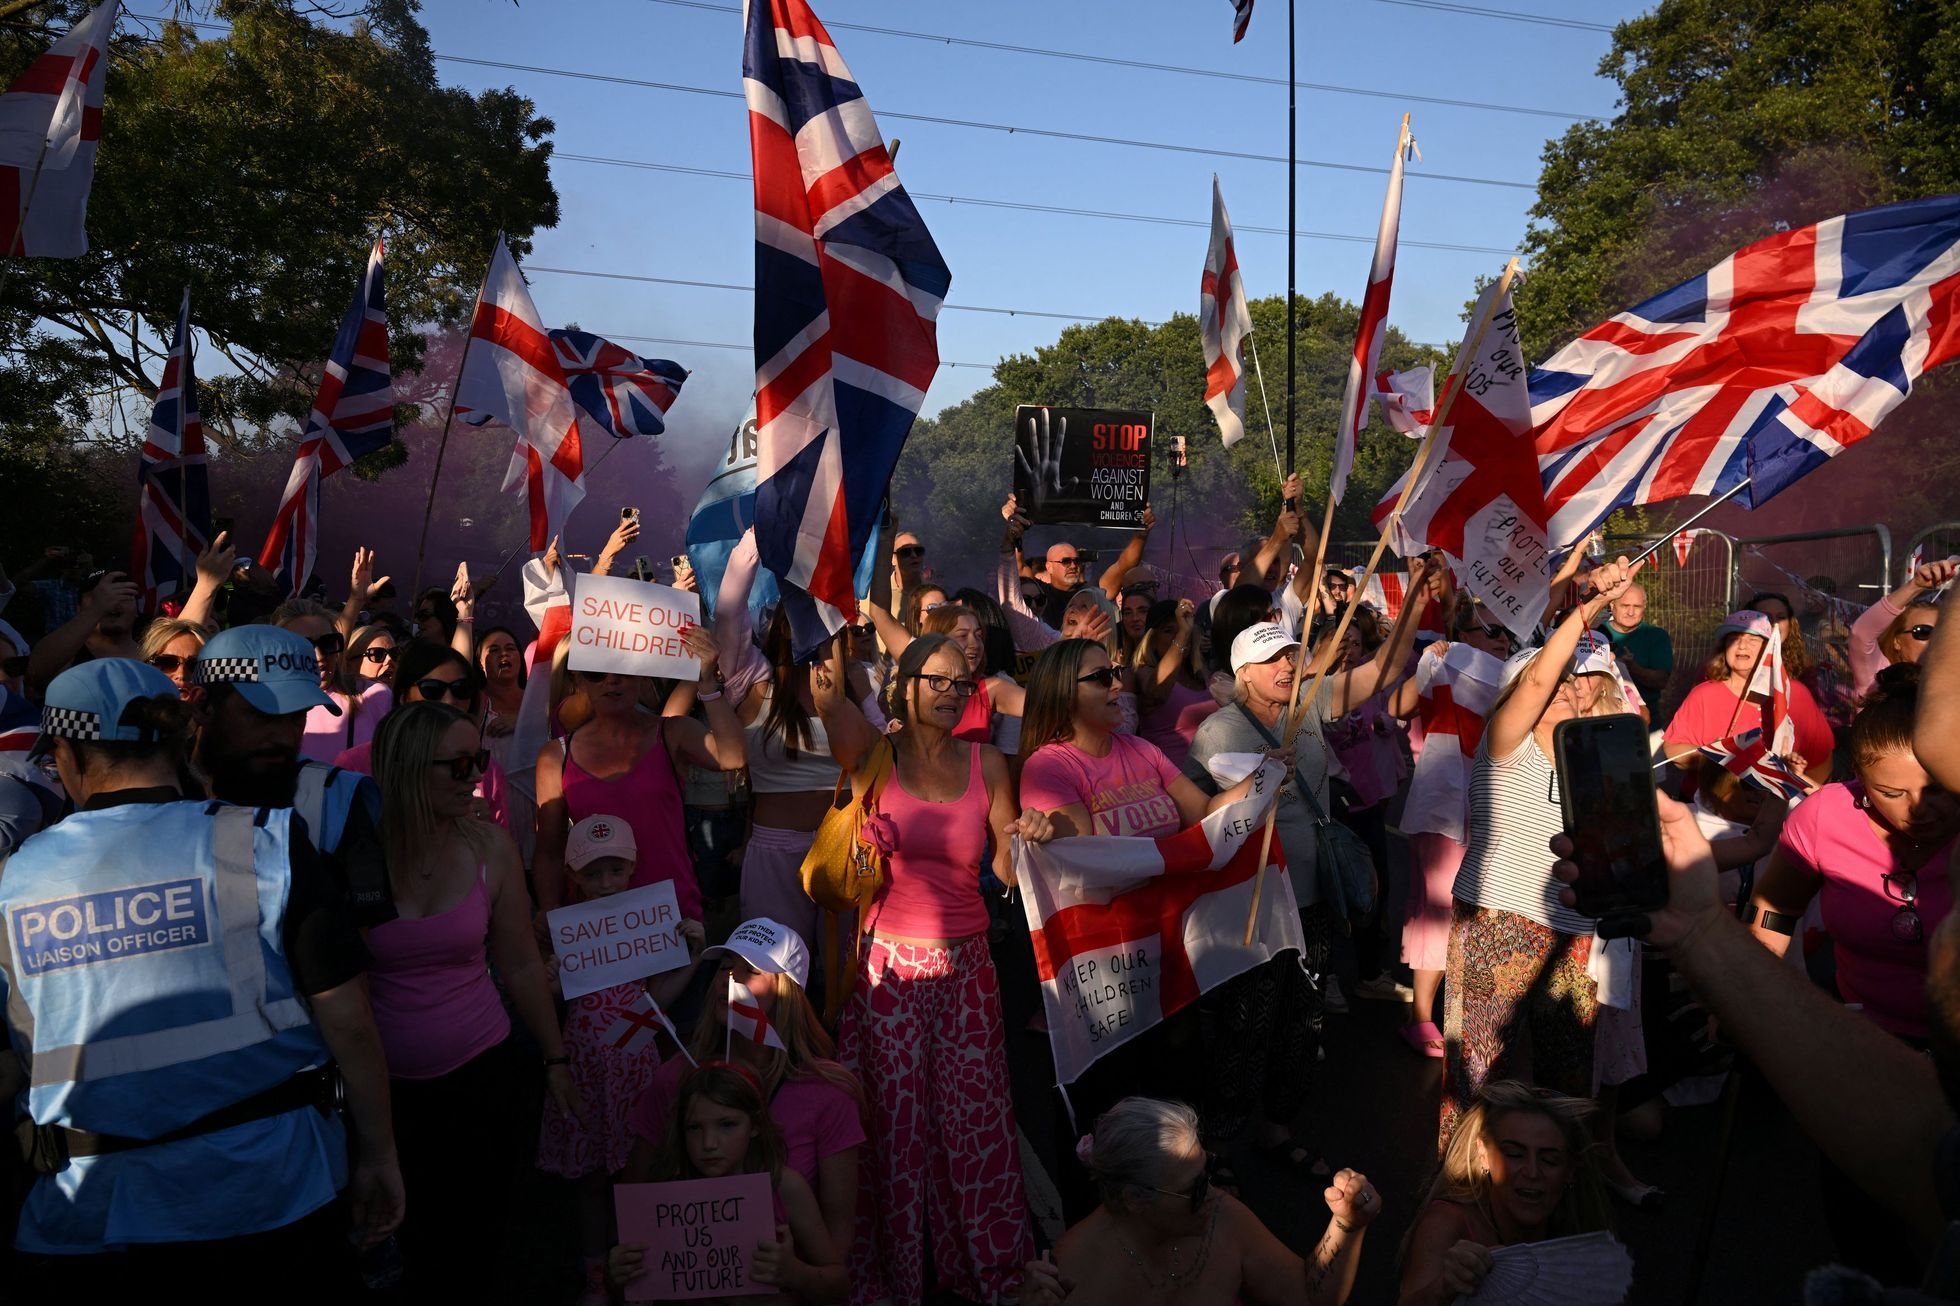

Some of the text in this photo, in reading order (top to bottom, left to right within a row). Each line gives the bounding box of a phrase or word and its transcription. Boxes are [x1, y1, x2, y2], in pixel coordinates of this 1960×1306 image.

[1490, 350, 1523, 381] OUR
[1466, 367, 1495, 396] IDS
[1093, 423, 1147, 451] STOP
[1092, 453, 1146, 468] VIOLENCE
[1091, 468, 1145, 485] AGAINST
[1090, 484, 1144, 501] WOMEN
[1110, 501, 1125, 511] AND
[1100, 510, 1133, 521] CHILDREN
[1497, 557, 1525, 584] OUR
[1470, 560, 1523, 616] FUTURE
[582, 597, 695, 630] SAVE OUR
[577, 626, 695, 659] CHILDREN
[1253, 634, 1266, 644] HOME
[1224, 818, 1253, 842] KEE
[20, 885, 195, 948] POLICE
[560, 904, 673, 945] SAVE OUR
[758, 924, 776, 937] THEM
[28, 925, 196, 969] LIAISON OFFICER
[562, 929, 680, 973] CHILDREN
[748, 930, 777, 946] PROTECT
[748, 937, 764, 946] KIDS
[1063, 949, 1149, 997] KEEP OUR
[1075, 977, 1152, 1018] CHILDREN
[1090, 1009, 1130, 1042] SAFE
[656, 1197, 745, 1228] PROTECT
[684, 1225, 713, 1248] US
[661, 1245, 743, 1272] AND OUR
[671, 1265, 744, 1293] FUTURE
